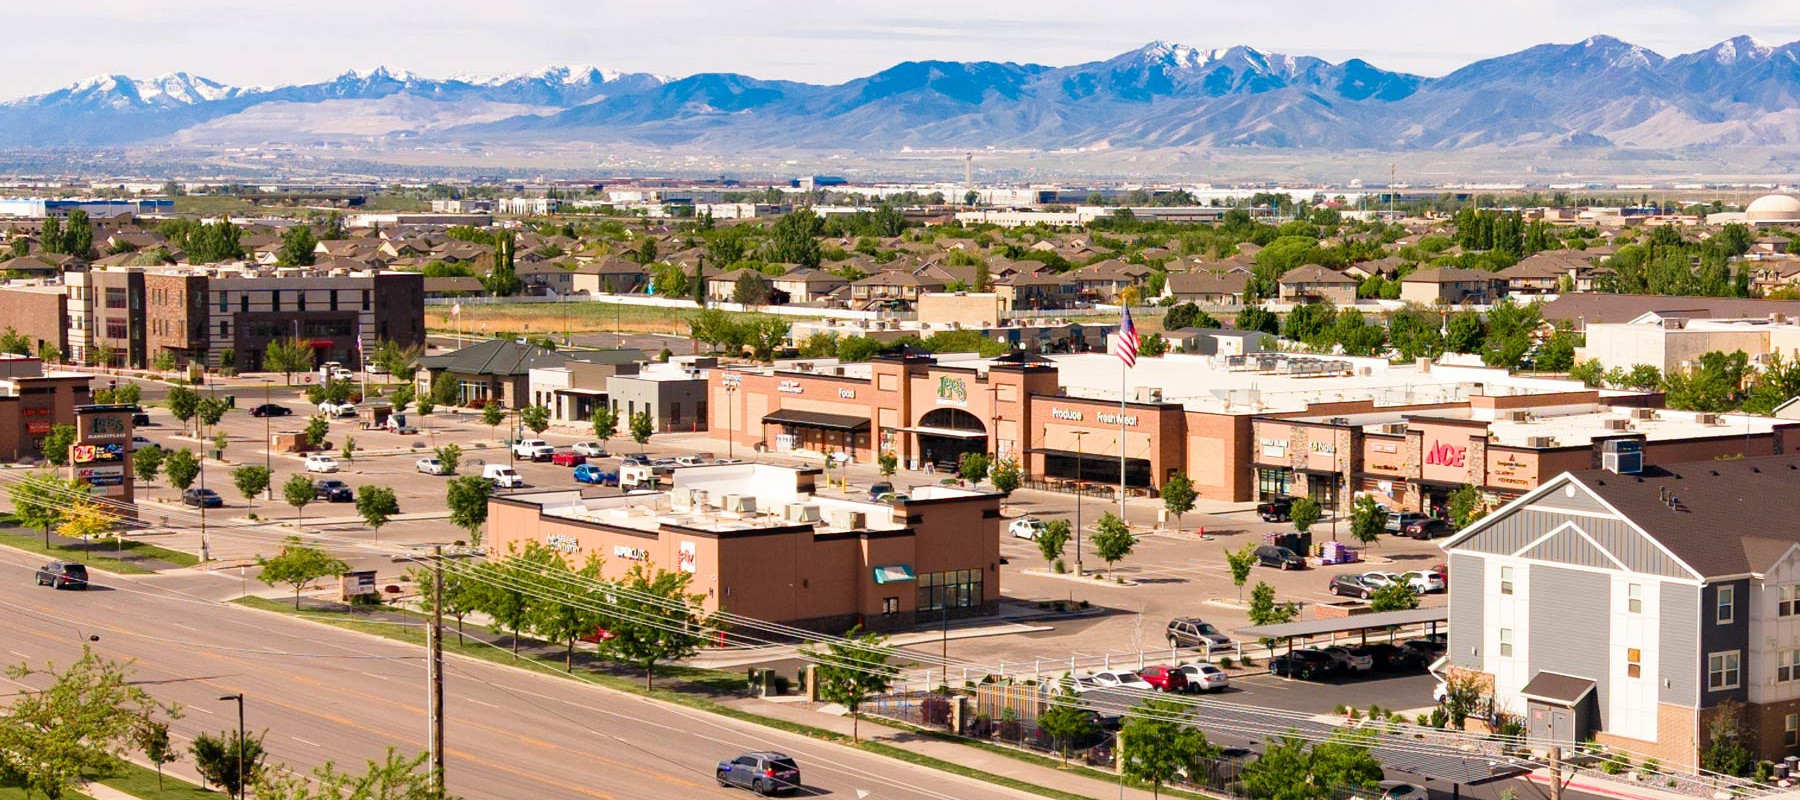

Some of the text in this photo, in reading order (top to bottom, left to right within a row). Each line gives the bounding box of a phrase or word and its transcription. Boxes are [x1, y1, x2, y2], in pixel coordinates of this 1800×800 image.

[839, 387, 855, 398] Food
[1052, 407, 1082, 421] Produce
[1097, 411, 1115, 424] Fresh
[1426, 439, 1466, 467] ACE
